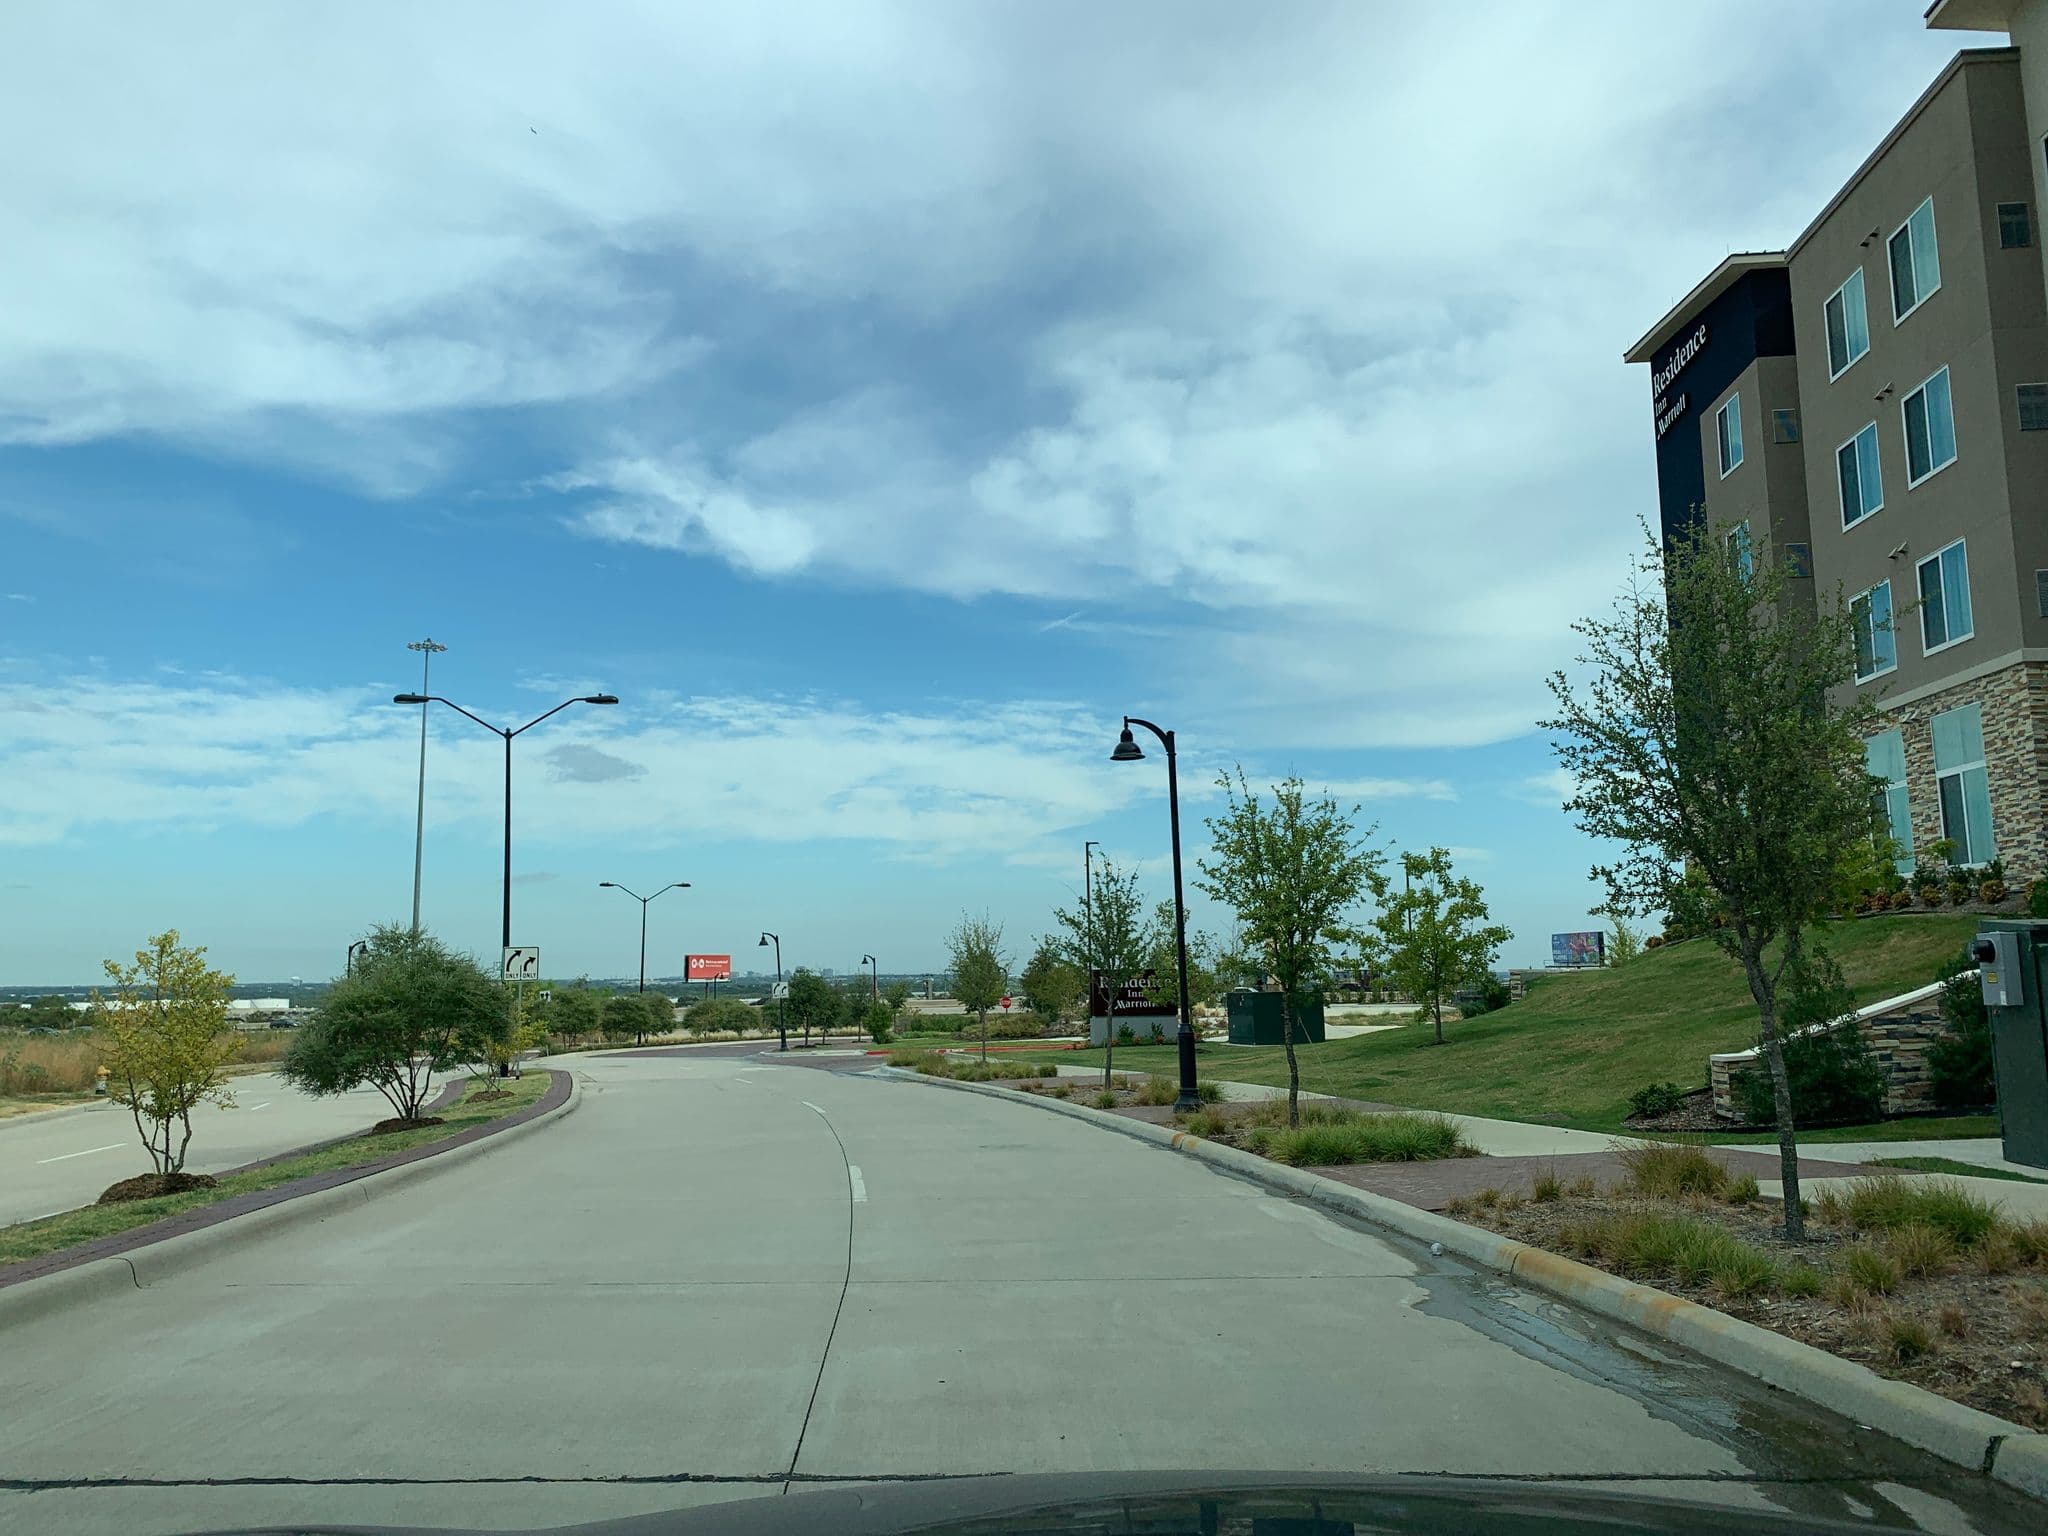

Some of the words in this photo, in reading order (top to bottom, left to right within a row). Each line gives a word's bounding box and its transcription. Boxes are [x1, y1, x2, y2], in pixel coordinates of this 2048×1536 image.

[1652, 323, 1707, 400] Residence
[1655, 396, 1668, 417] Inn
[1656, 392, 1687, 441] Marriott
[1099, 975, 1172, 989] Ridene
[1127, 989, 1144, 998] Inn
